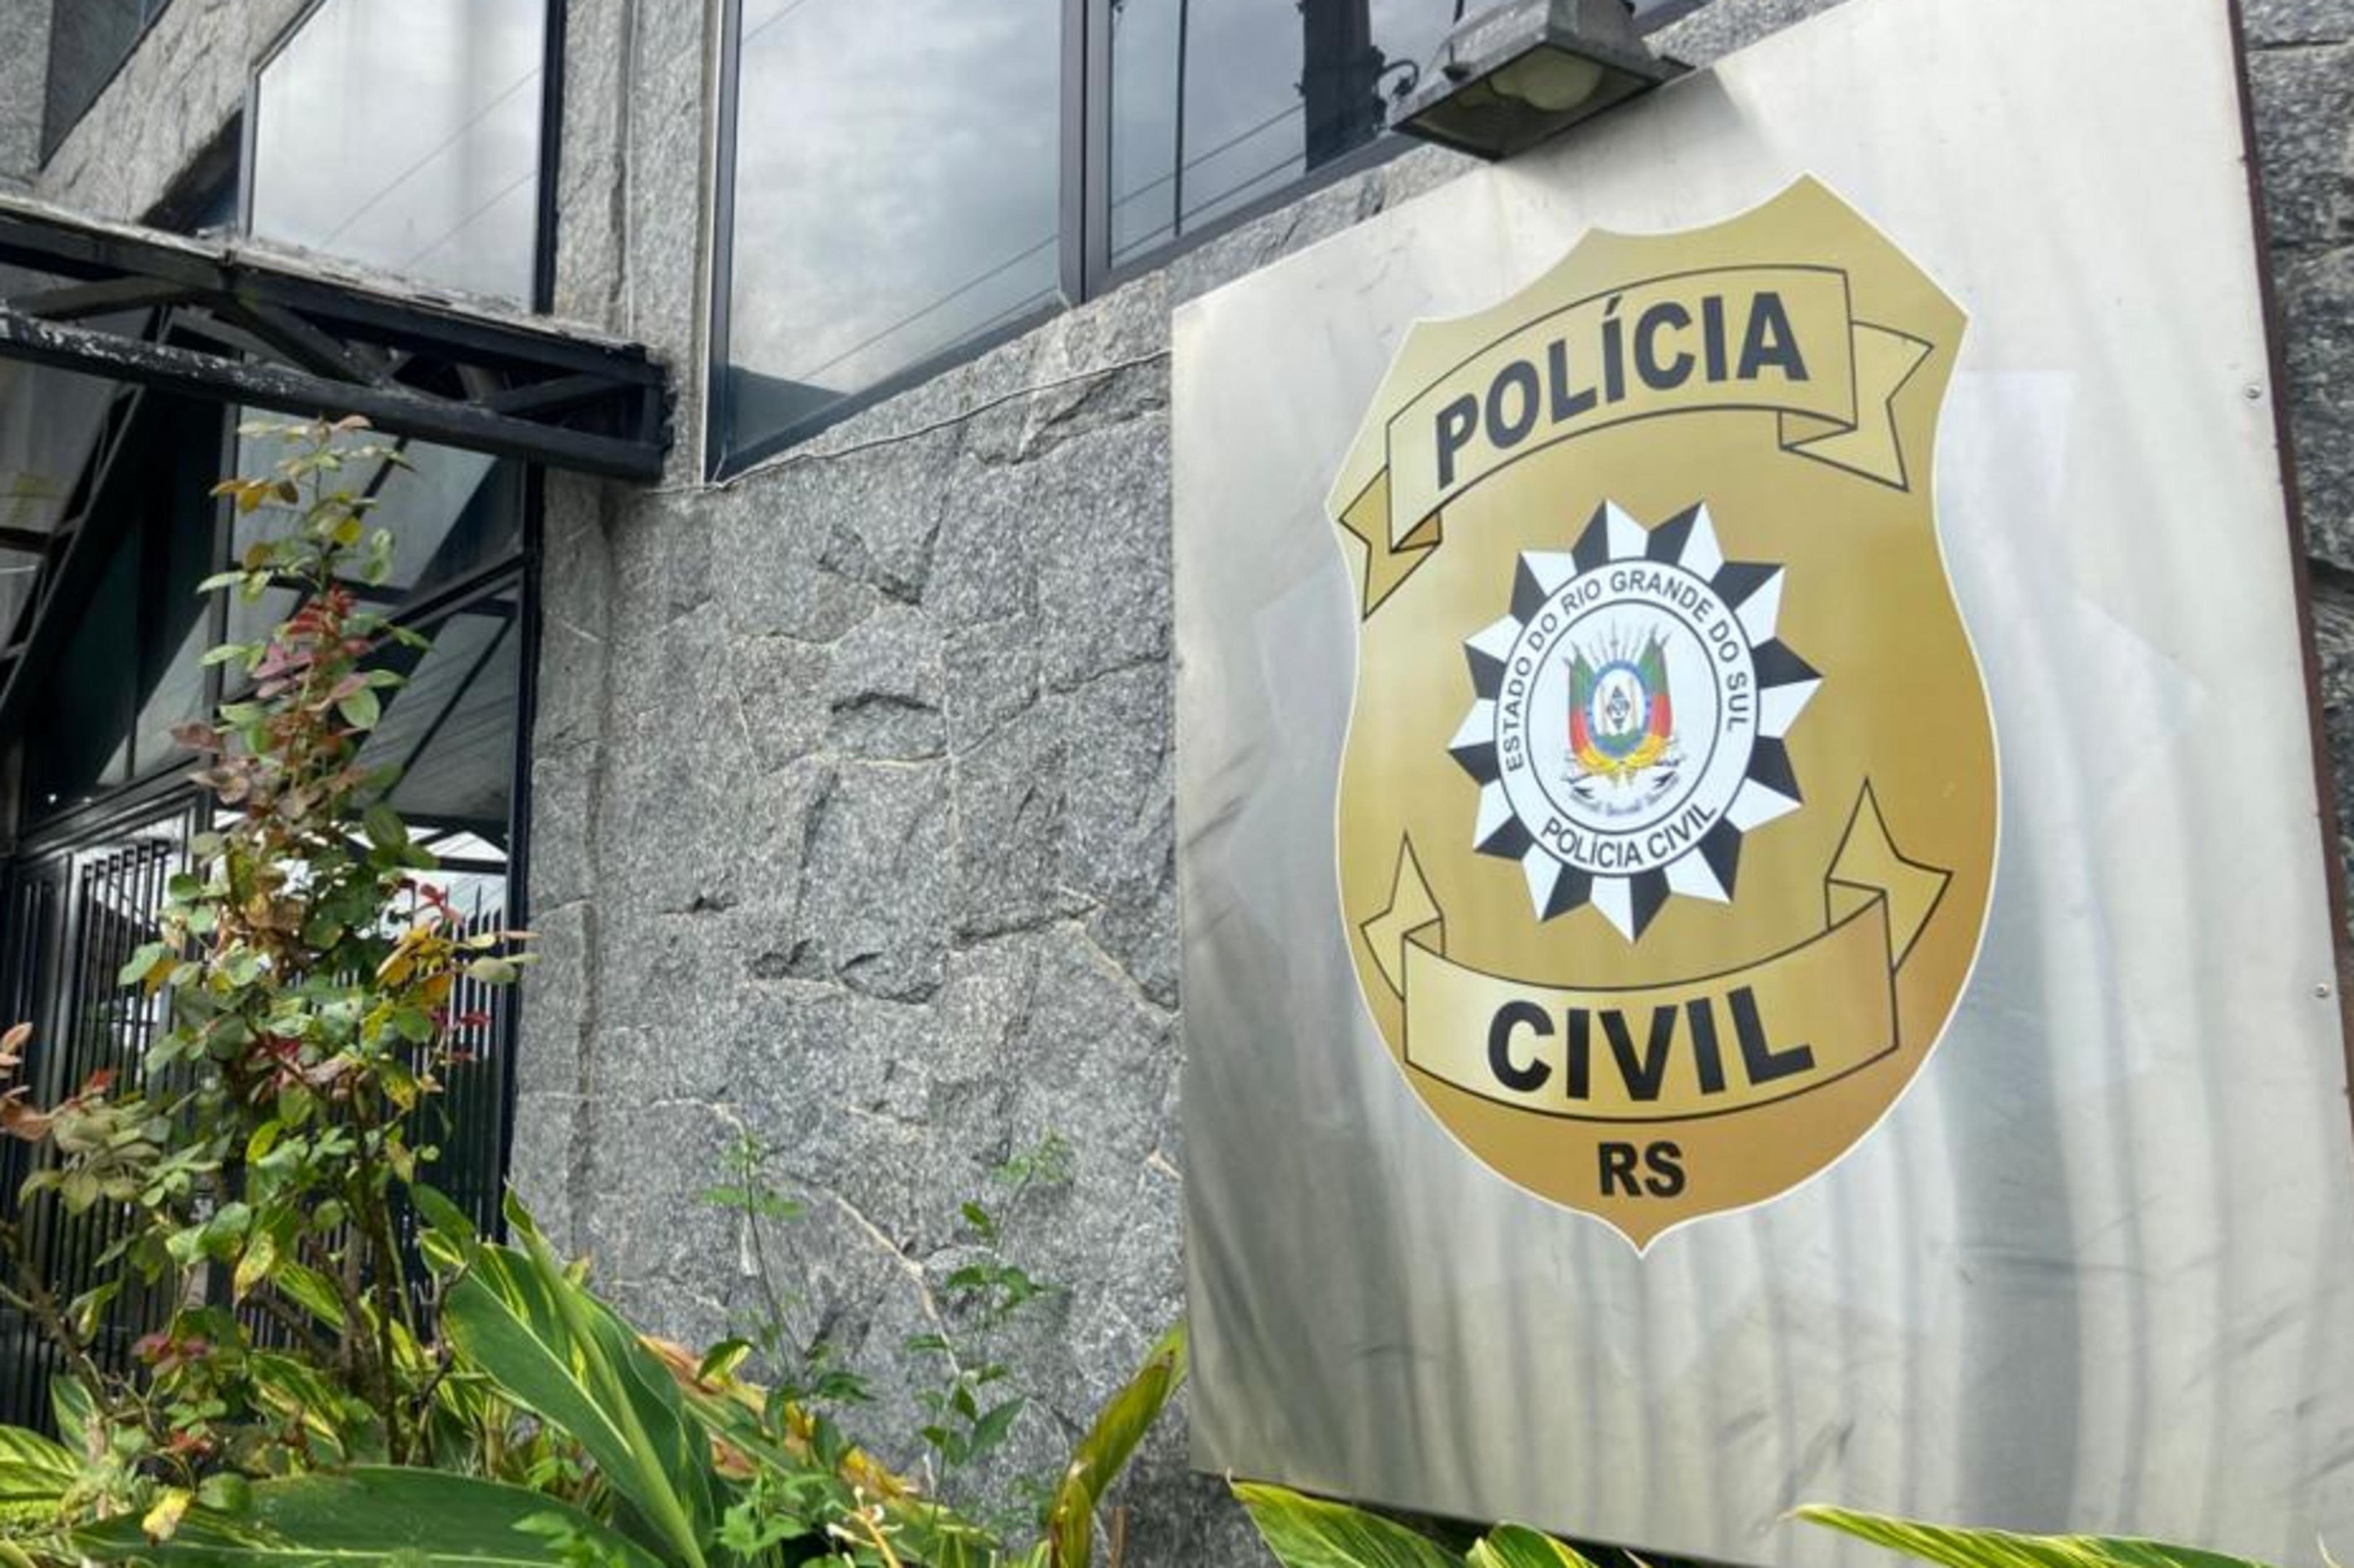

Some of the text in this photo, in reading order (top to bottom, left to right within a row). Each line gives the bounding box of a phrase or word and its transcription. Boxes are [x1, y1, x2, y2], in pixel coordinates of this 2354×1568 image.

[1435, 292, 1809, 490] POLÍCIA
[1503, 570, 1749, 772] ESTADO DO RIO GRANDE DO SUL
[1540, 803, 1717, 867] POLÍCIA CIVIL
[1488, 986, 1816, 1101] CIVIL
[1598, 1140, 1686, 1198] RS
